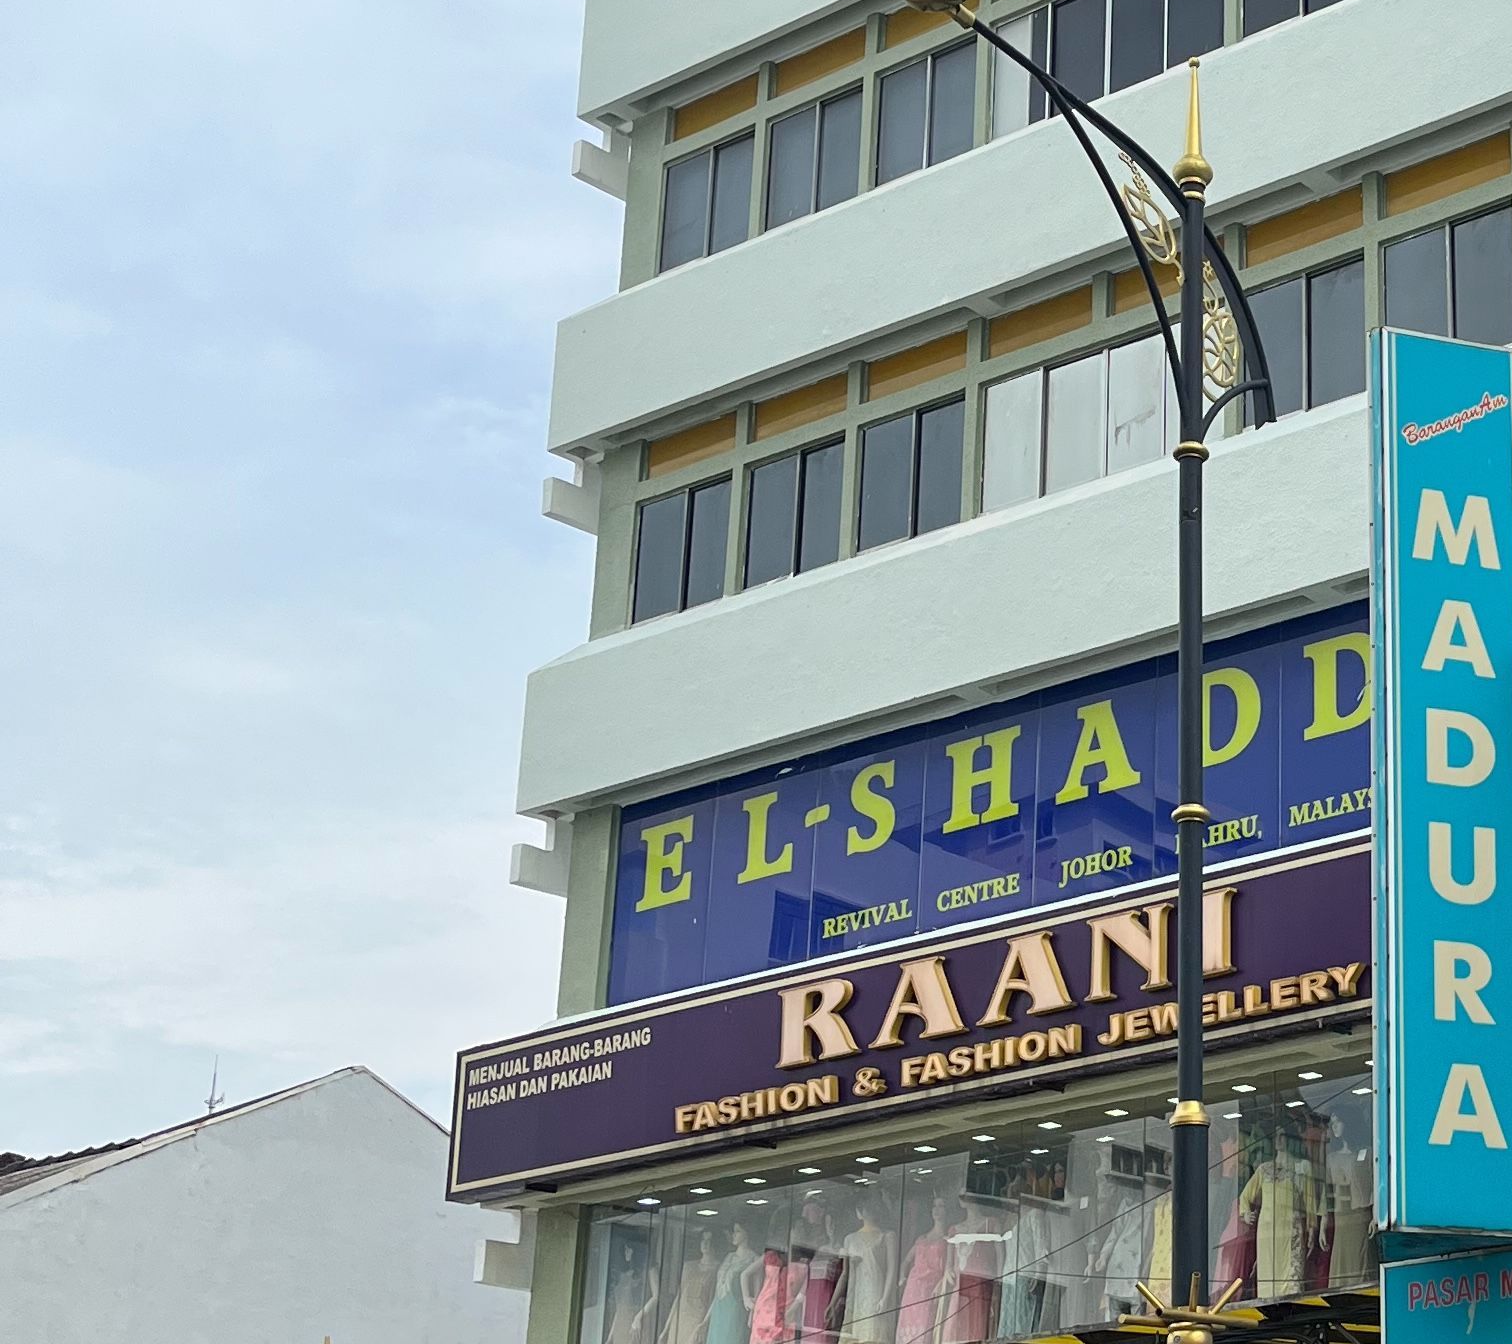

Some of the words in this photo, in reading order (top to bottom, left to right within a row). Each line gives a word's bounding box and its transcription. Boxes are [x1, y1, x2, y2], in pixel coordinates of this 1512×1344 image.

[1411, 488, 1508, 1150] MADURA
[822, 898, 912, 939] REVIVAL
[936, 872, 1021, 912] CENTRE
[1059, 845, 1133, 888] JOHOR
[1175, 814, 1263, 854] HRU,
[774, 885, 1238, 1069] RAANI
[467, 1083, 516, 1110] HIASAN
[519, 1075, 547, 1098] DAN
[550, 1060, 612, 1091] PAKAIAN
[469, 1056, 530, 1087] MENJUAL
[533, 1027, 651, 1072] BARANG-BARANG
[674, 1074, 839, 1133] FASHION
[852, 1064, 885, 1098] &
[899, 1024, 1082, 1088] FASHION
[1408, 1272, 1489, 1312] PASAR
